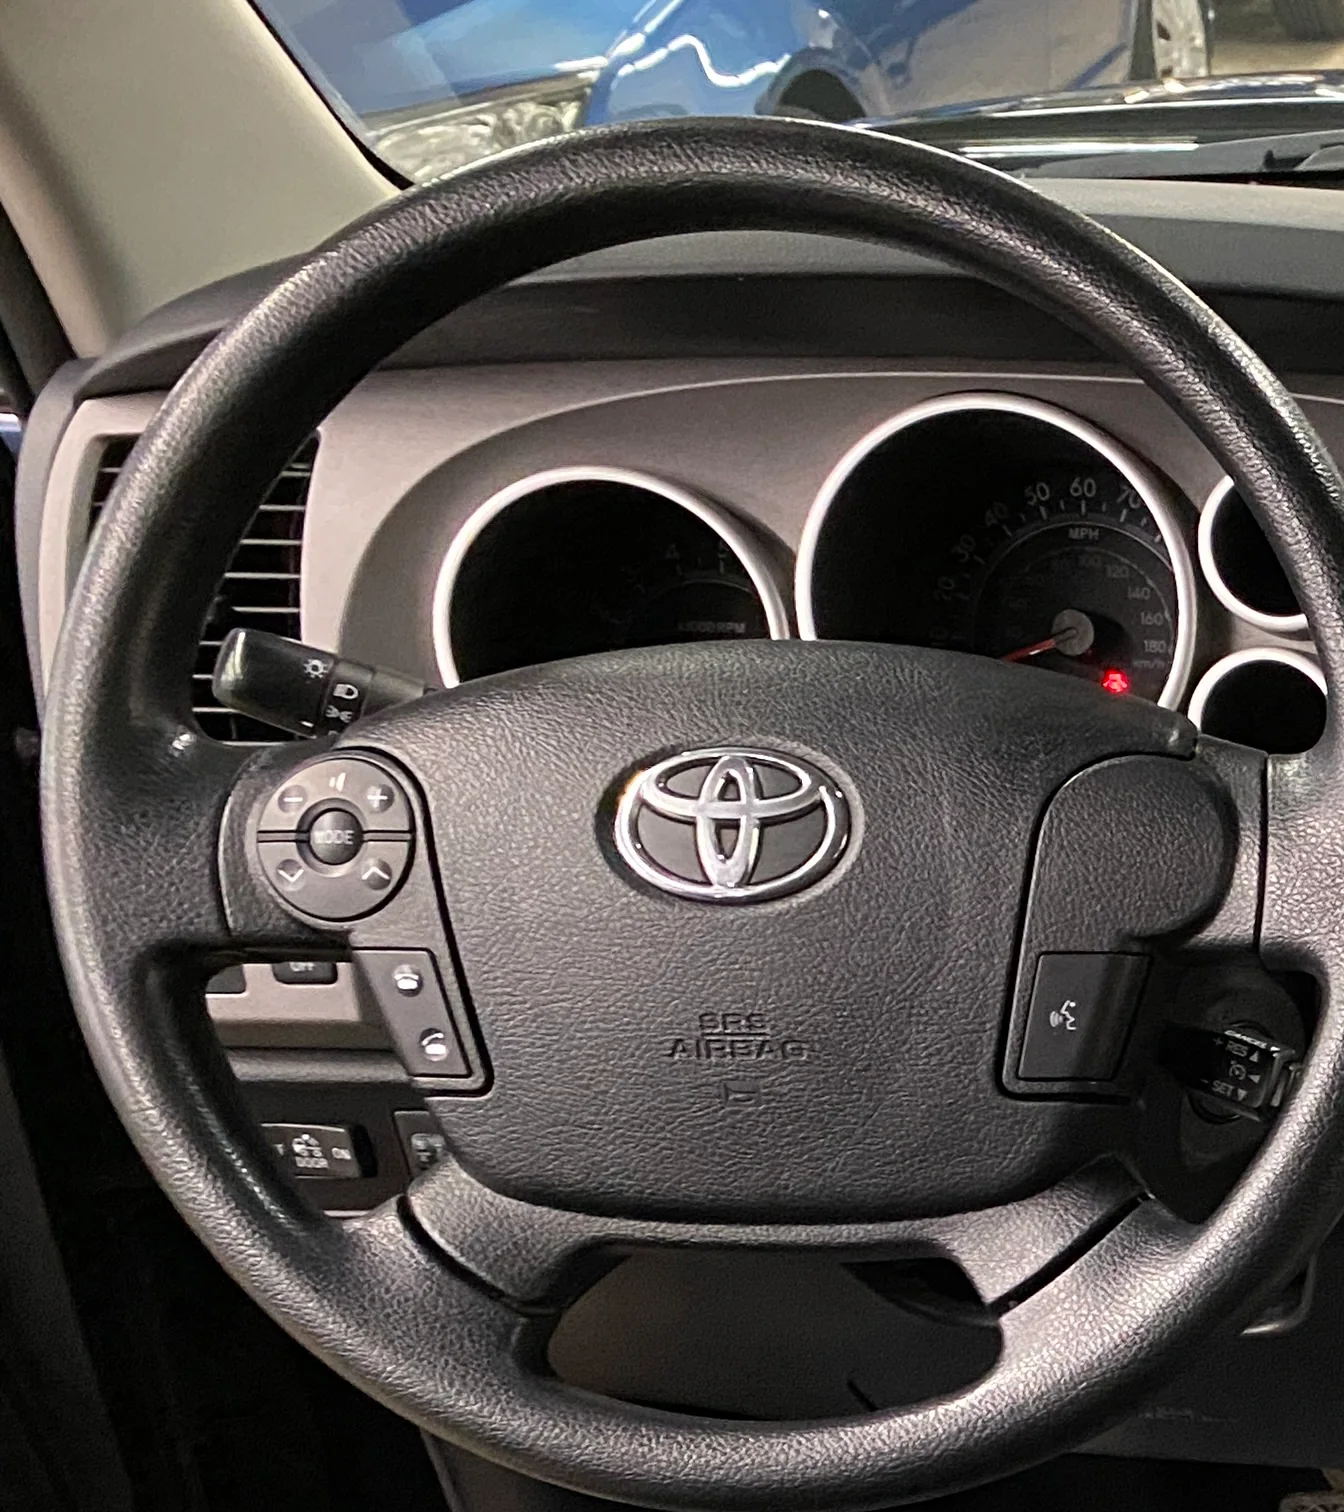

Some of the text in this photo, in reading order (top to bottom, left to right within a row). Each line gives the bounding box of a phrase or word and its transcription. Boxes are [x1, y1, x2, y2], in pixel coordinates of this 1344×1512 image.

[1024, 482, 1050, 506] 50
[1069, 476, 1097, 498] 60
[1068, 528, 1100, 540] MPH
[313, 829, 355, 845] MODE
[698, 1011, 767, 1032] SRS
[663, 1037, 811, 1060] AIRBAG
